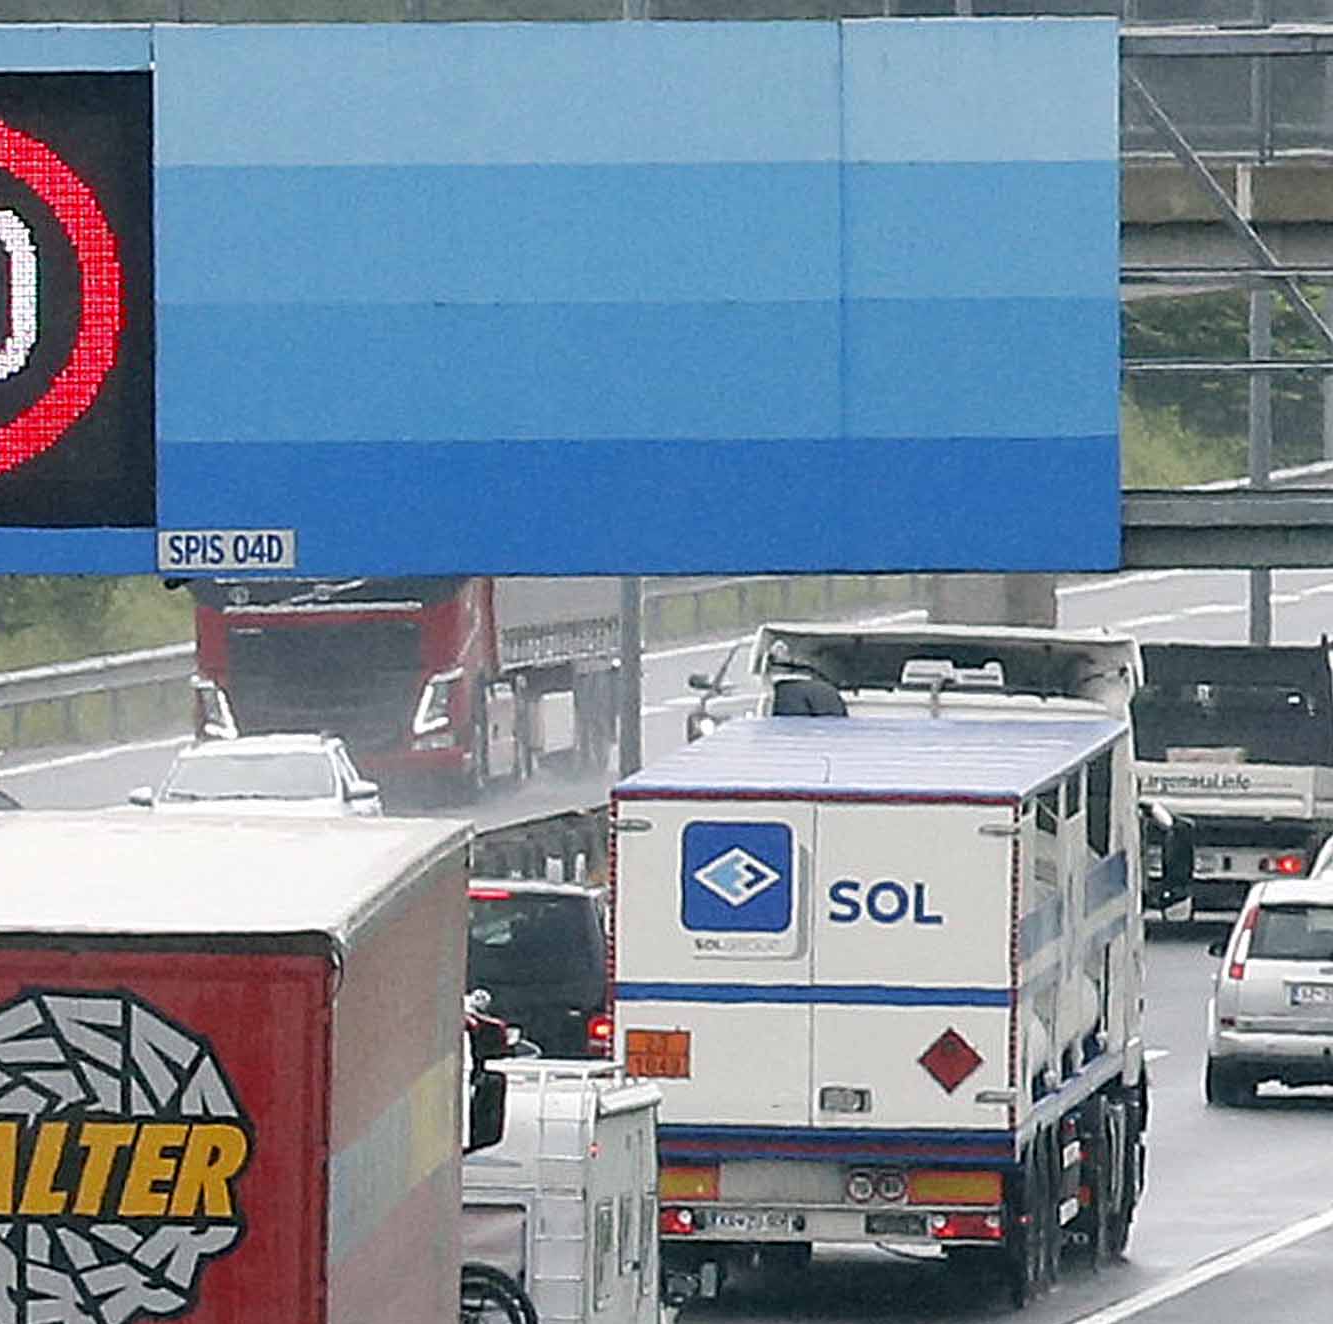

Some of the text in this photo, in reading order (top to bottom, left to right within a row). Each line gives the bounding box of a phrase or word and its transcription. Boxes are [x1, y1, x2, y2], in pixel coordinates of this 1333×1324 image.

[169, 533, 284, 564] SPIS 04D
[827, 881, 943, 925] SOL
